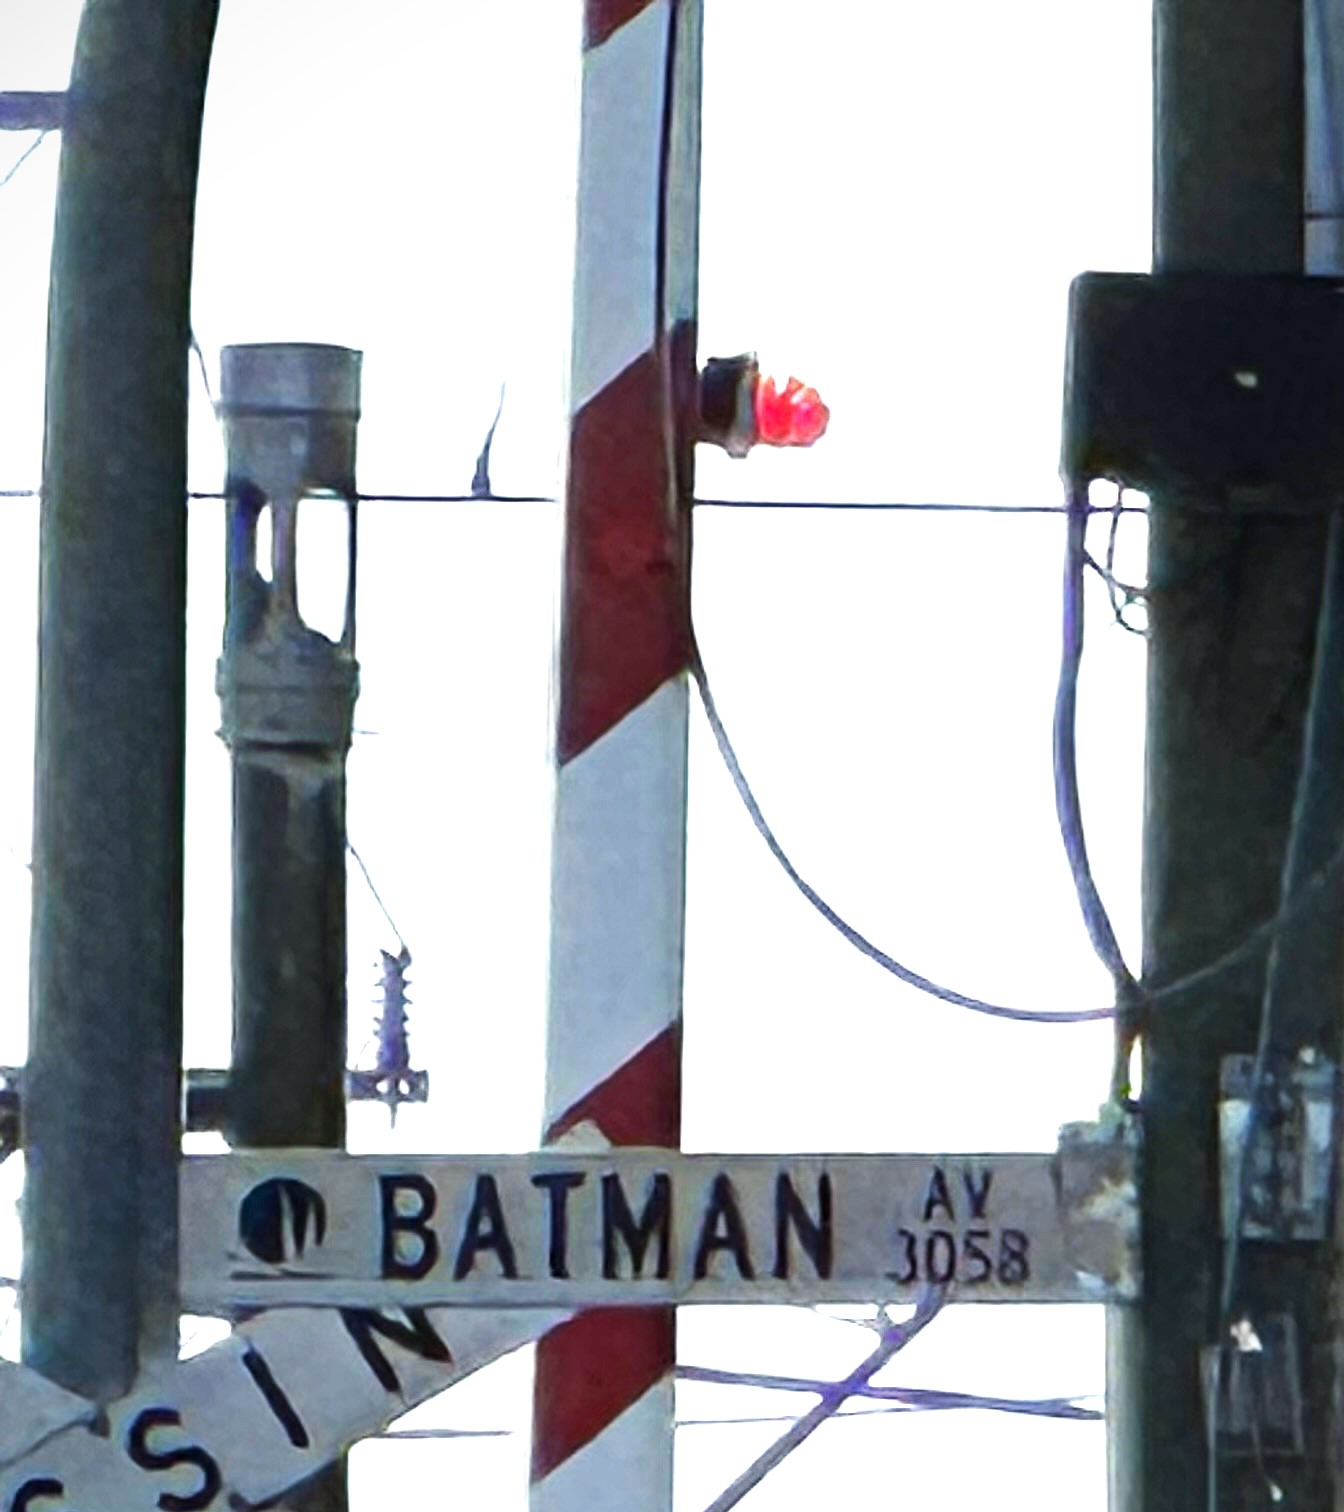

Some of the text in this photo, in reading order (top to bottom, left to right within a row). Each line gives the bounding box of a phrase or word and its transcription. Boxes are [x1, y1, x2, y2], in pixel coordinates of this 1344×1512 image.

[380, 1165, 995, 1282] BATMAN AV
[886, 1227, 1034, 1287] 3058
